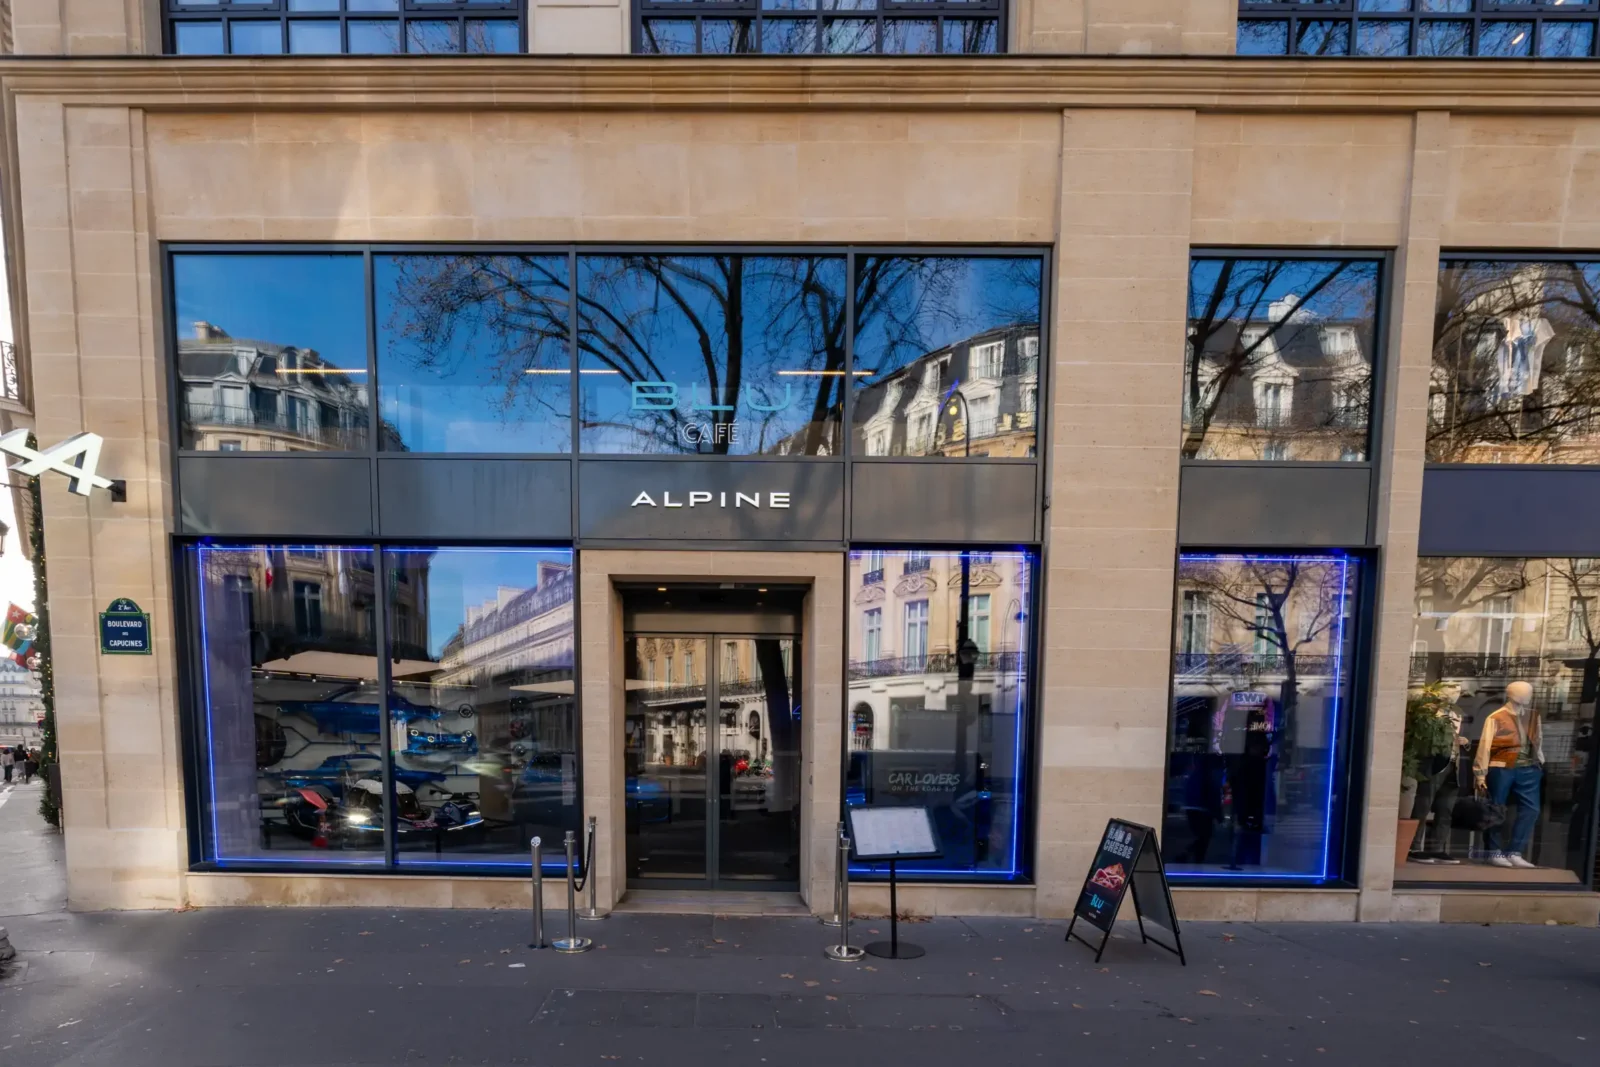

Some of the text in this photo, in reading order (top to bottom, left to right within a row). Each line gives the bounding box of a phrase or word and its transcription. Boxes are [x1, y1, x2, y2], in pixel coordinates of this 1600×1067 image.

[631, 381, 791, 411] BLU
[682, 419, 740, 445] CAFÉ
[631, 490, 791, 509] ALPINE
[107, 620, 142, 628] BOULEVARD
[109, 639, 143, 647] CAPUCINES
[1235, 693, 1264, 703] BWT
[888, 772, 960, 786] CAR LOVERS
[1103, 839, 1134, 859] CHEESE
[1090, 893, 1105, 909] BLU
